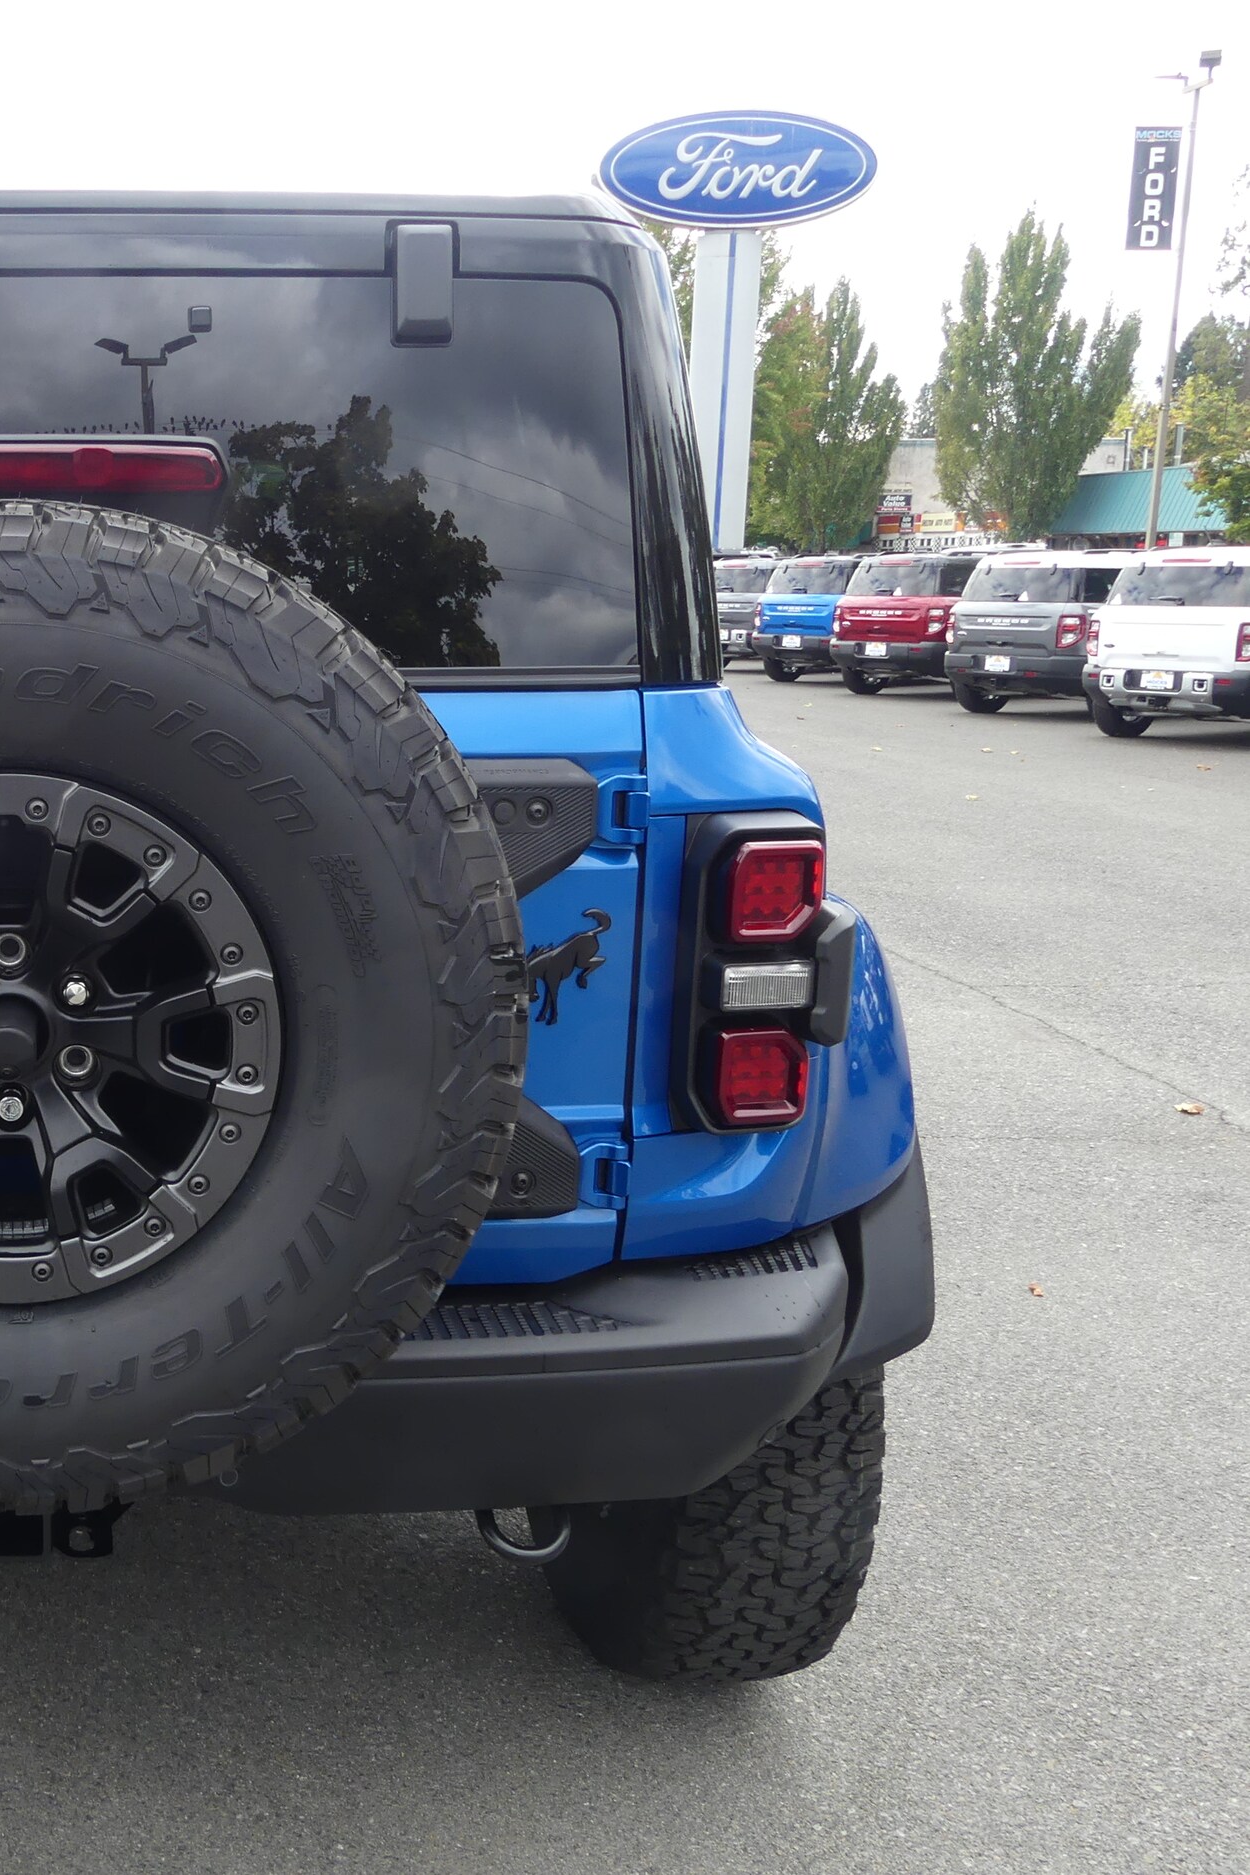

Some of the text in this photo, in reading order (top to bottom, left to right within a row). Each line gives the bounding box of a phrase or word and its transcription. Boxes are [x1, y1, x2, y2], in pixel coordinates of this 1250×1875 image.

[658, 132, 822, 200] Ford
[1136, 130, 1181, 139] MOCKS
[1140, 147, 1166, 247] FORD
